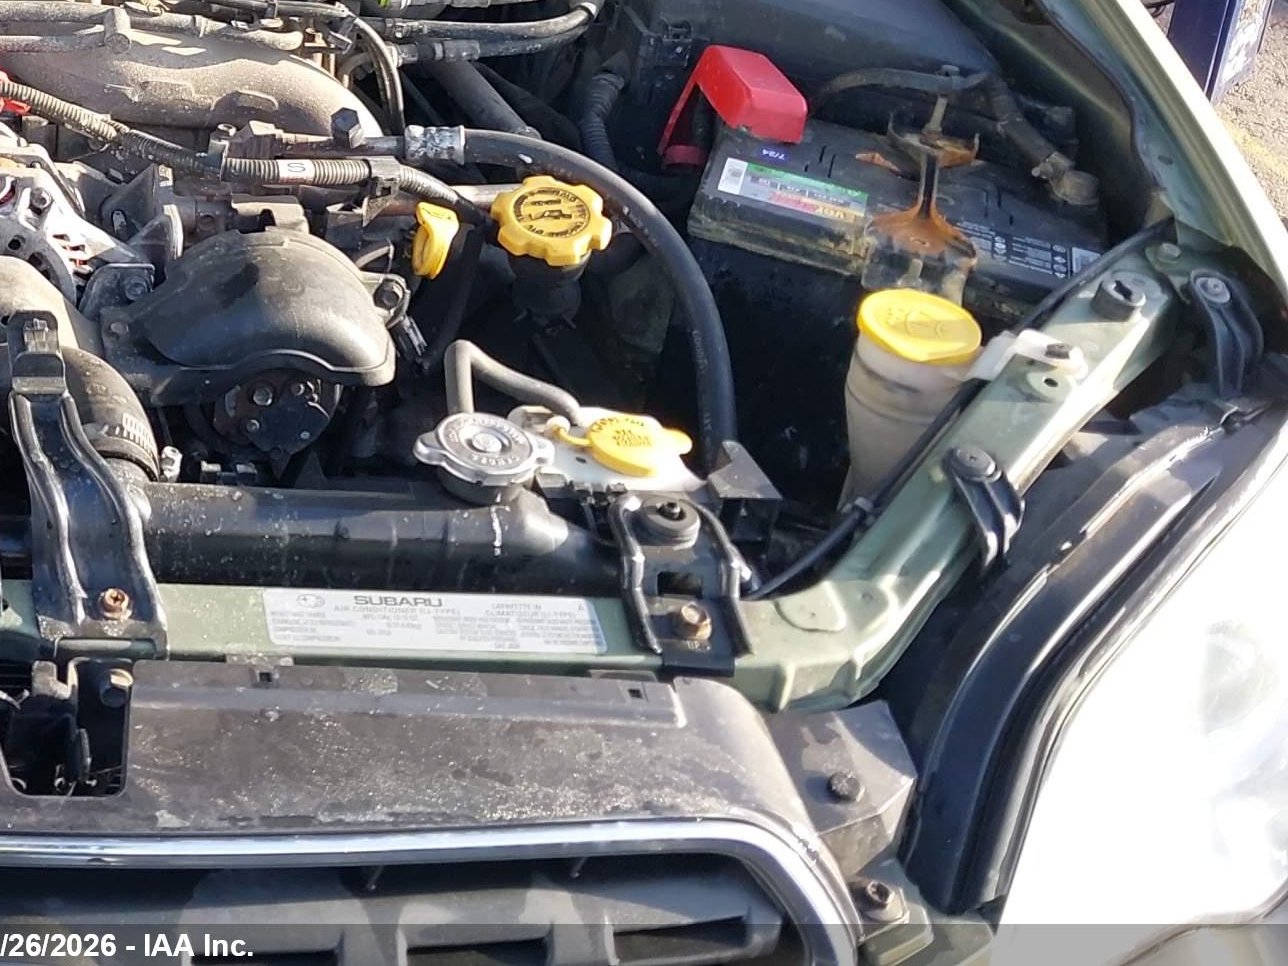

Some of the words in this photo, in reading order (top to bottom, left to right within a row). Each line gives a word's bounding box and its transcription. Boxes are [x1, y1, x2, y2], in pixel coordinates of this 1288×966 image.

[762, 147, 787, 160] 7/24
[287, 162, 306, 173] S
[353, 595, 442, 607] SUBARU
[352, 605, 417, 614] CONDITIONER
